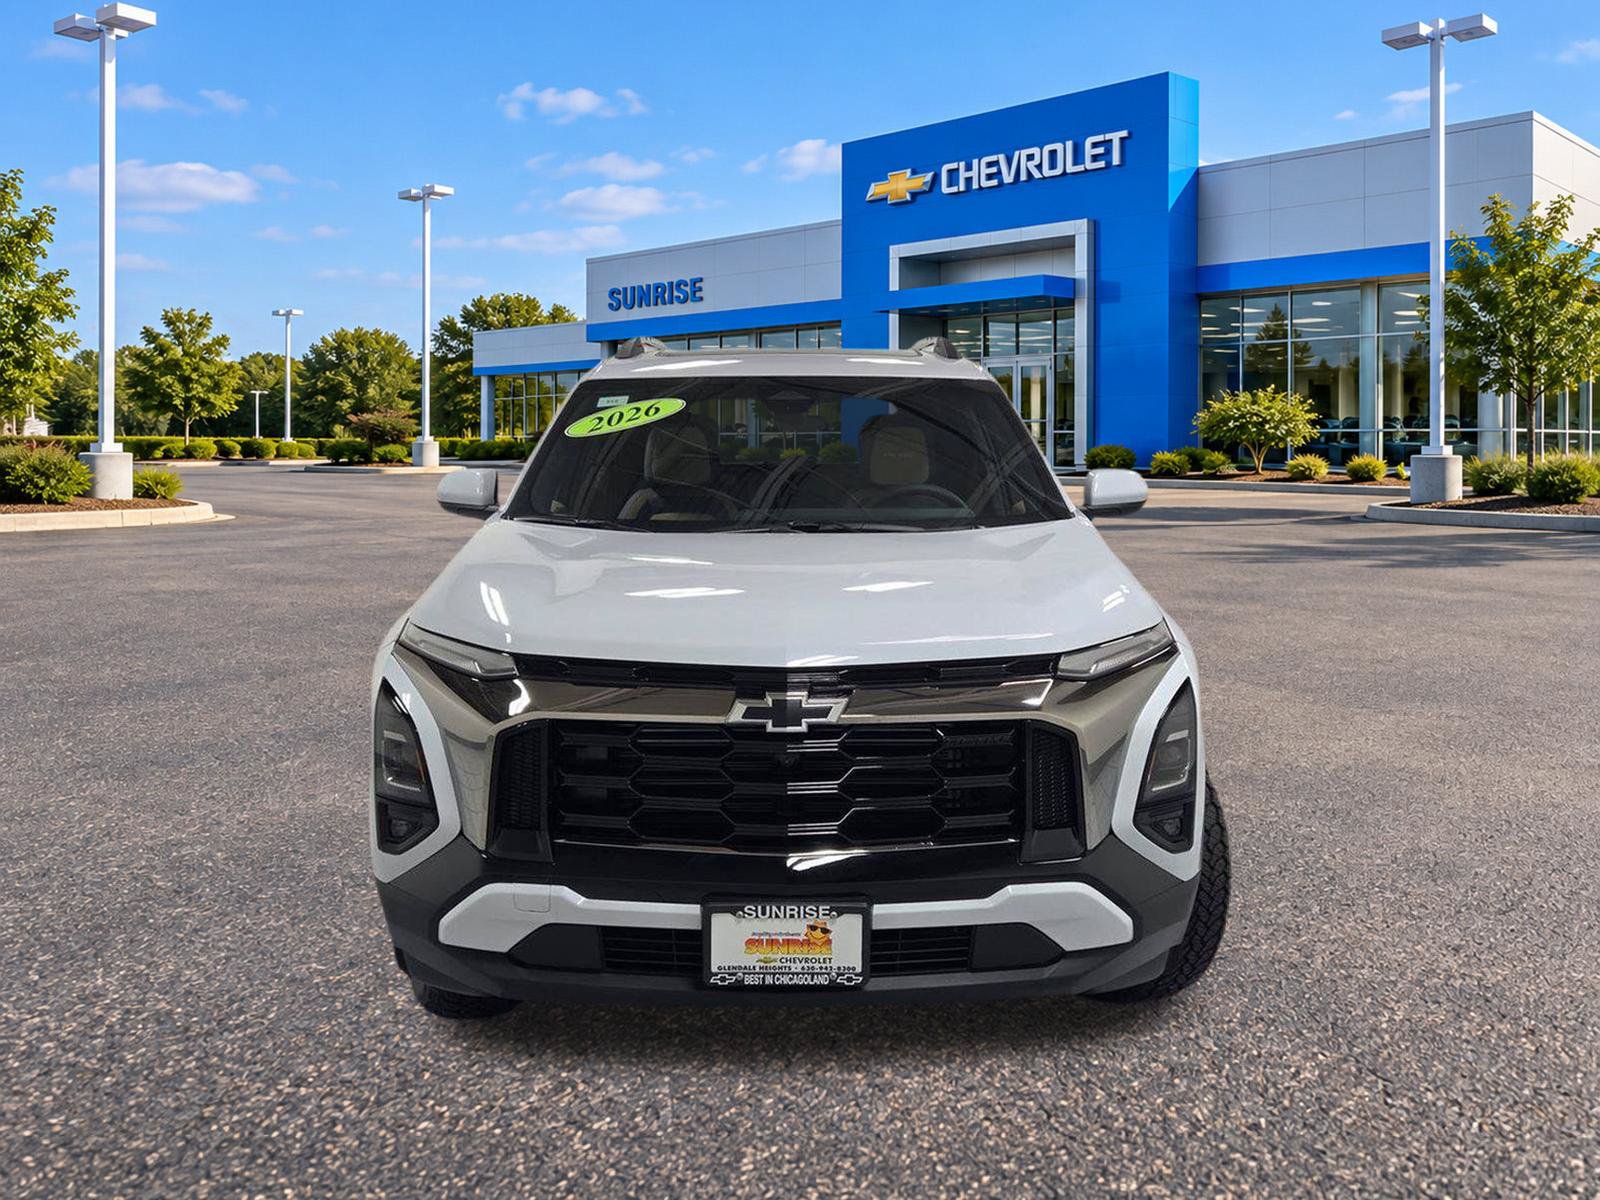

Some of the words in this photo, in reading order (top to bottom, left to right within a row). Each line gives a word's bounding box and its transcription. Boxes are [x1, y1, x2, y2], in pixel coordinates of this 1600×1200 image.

[941, 130, 1129, 195] CHEVROLET
[608, 277, 704, 312] SUNRISE
[587, 401, 662, 433] 2026
[743, 905, 831, 919] SUNRISE
[744, 973, 764, 985] BEST
[765, 974, 774, 985] IN
[775, 974, 829, 985] CHICAGOLAND
